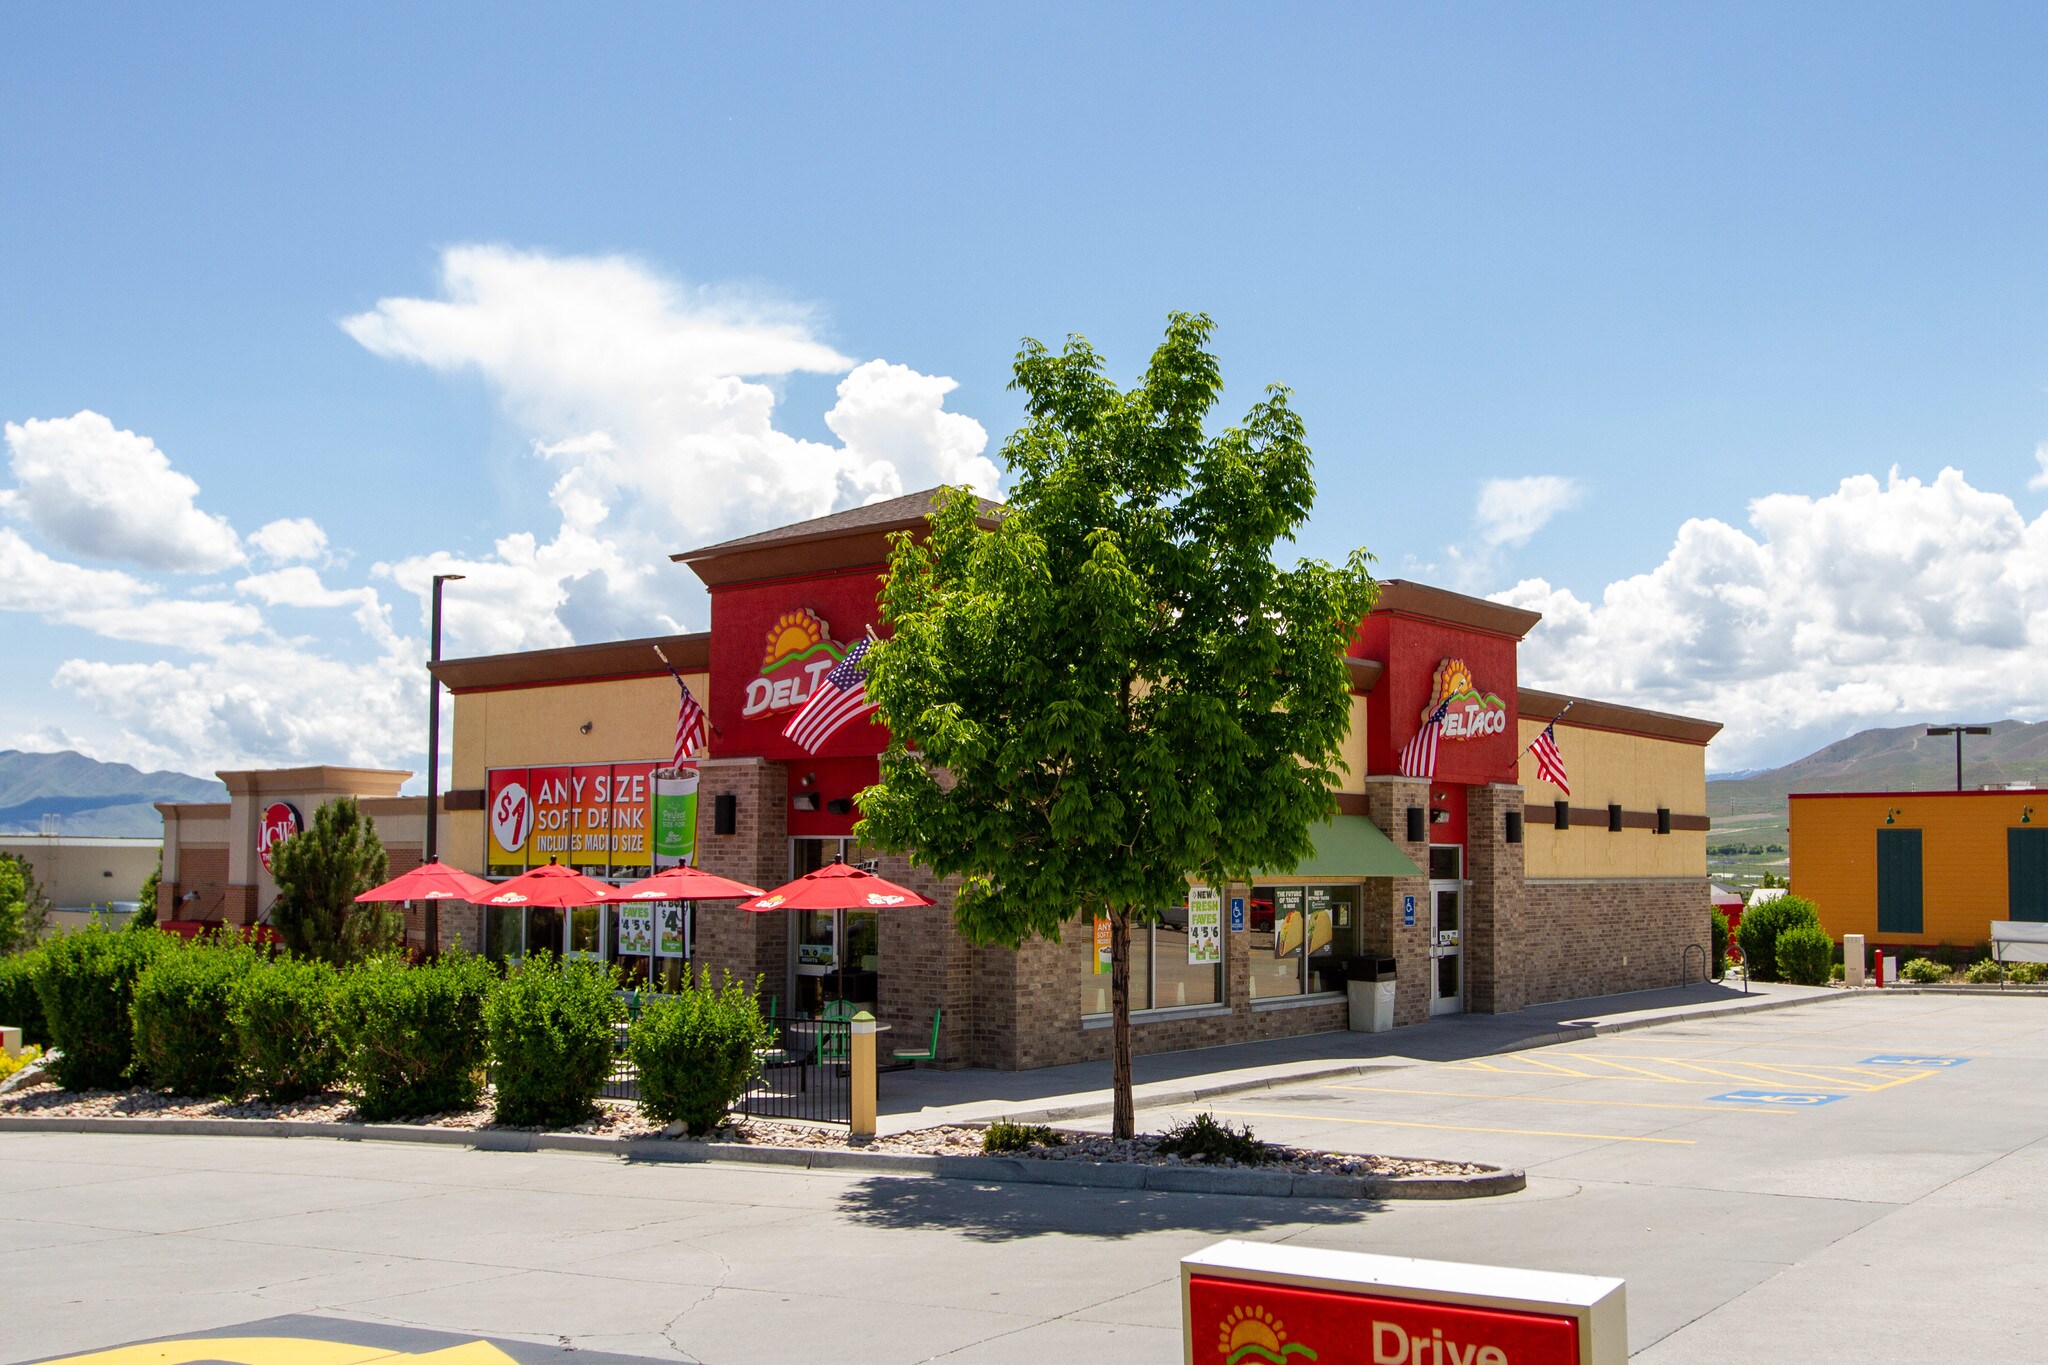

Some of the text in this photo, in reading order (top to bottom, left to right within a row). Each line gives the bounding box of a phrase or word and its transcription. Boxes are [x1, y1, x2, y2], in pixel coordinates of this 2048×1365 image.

[1465, 704, 1506, 738] TACO
[538, 775, 645, 805] ANY SIZE
[497, 790, 526, 846] $1
[538, 807, 645, 830] SOFT DRINK
[621, 834, 644, 852] SIZE
[1191, 900, 1218, 912] FRESH
[1197, 890, 1213, 899] NEW
[622, 907, 649, 918] FAVES
[661, 908, 679, 931] $4
[1192, 914, 1217, 925] FAVES
[1372, 1320, 1508, 1365] Drive
